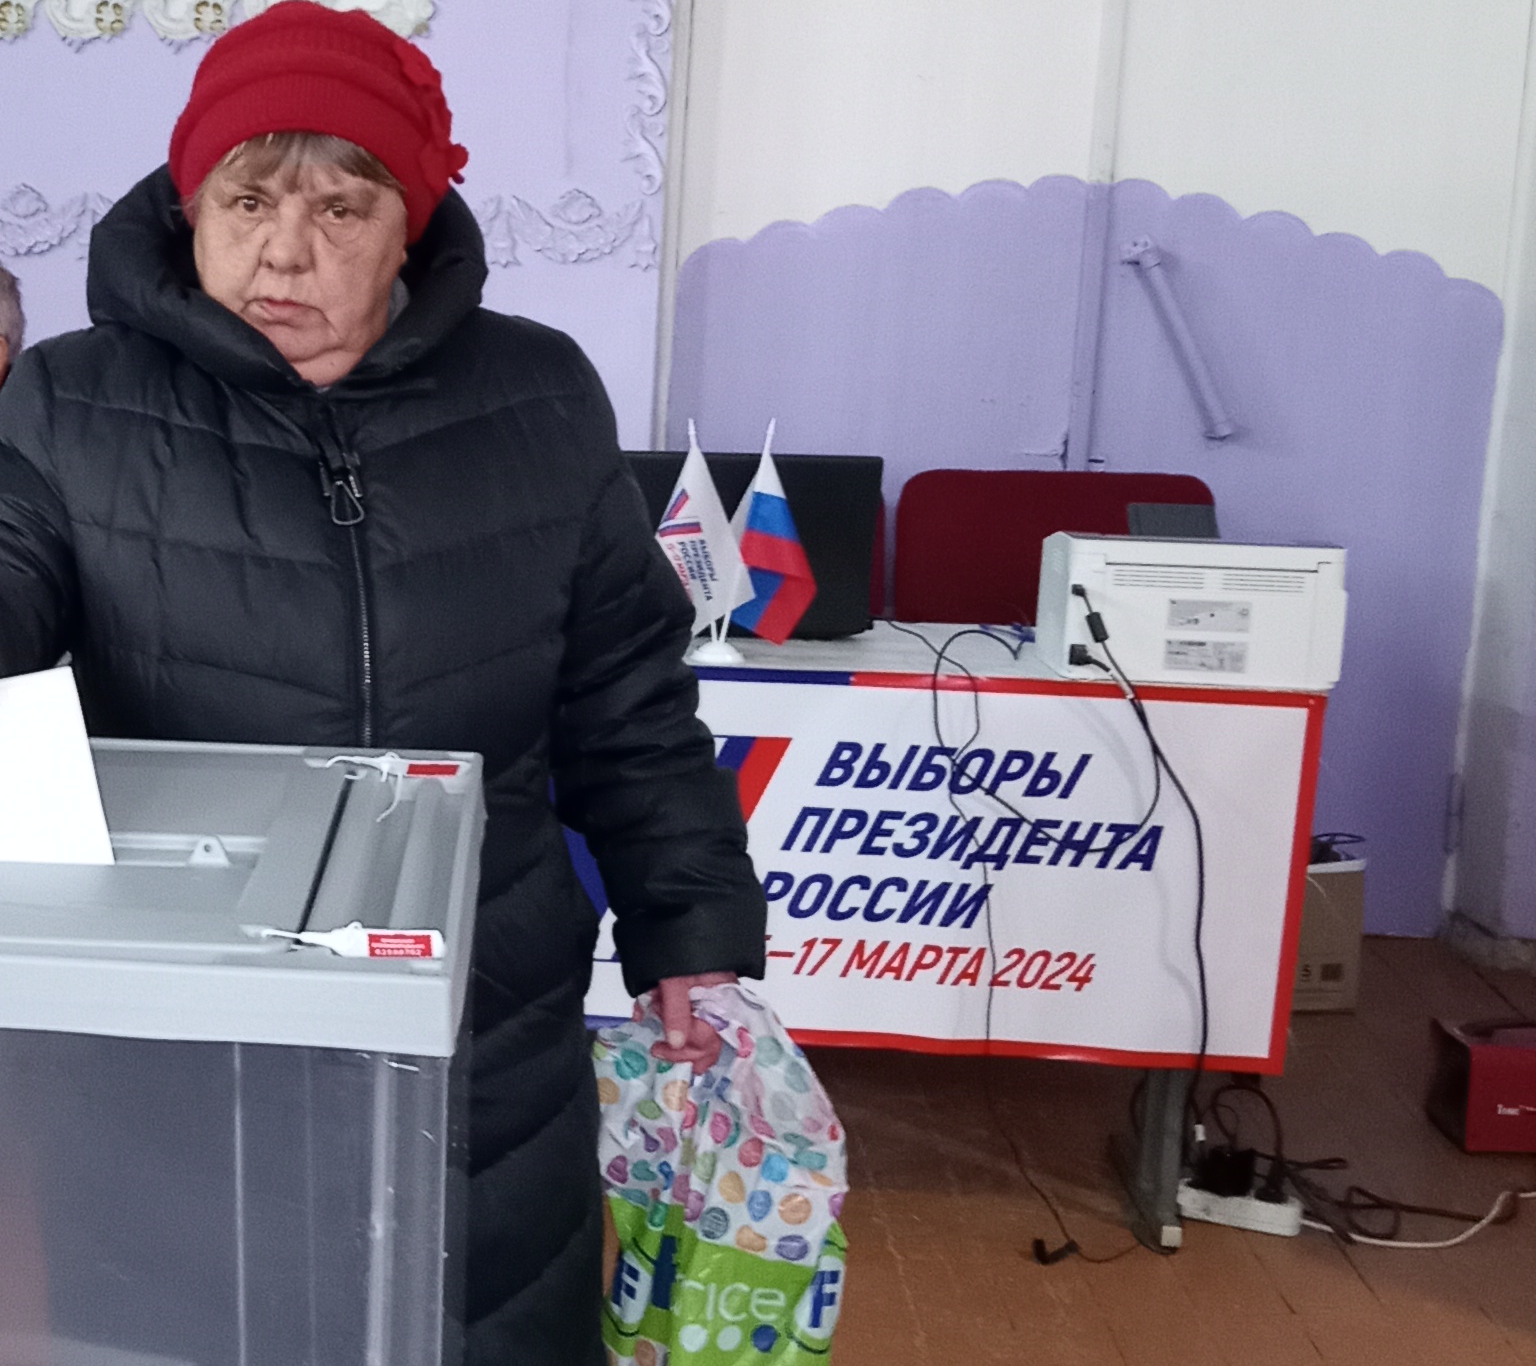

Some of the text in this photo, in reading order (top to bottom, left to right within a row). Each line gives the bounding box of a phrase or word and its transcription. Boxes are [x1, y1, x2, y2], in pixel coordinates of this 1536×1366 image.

[815, 741, 1092, 799] ВЫБОРЫ
[780, 806, 1163, 872] ПРЕЗИДЕНТА
[763, 871, 994, 928] РОССИИ
[839, 939, 986, 986] МАРТА
[990, 947, 1096, 992] 2024
